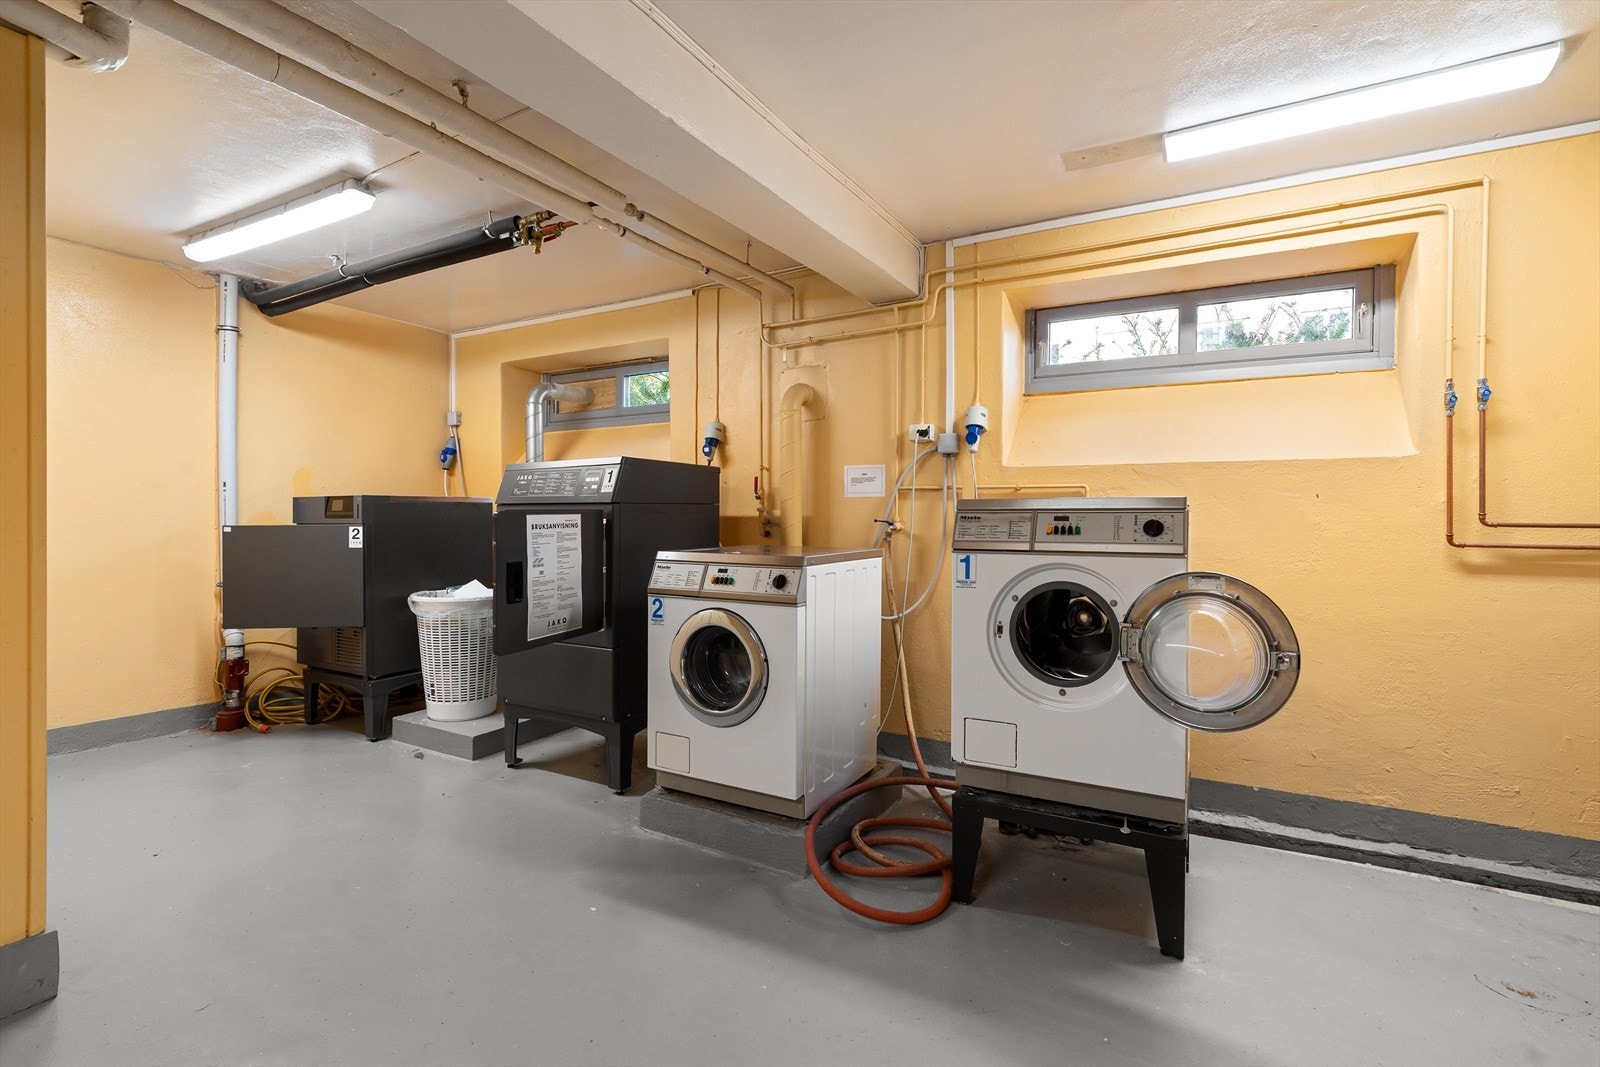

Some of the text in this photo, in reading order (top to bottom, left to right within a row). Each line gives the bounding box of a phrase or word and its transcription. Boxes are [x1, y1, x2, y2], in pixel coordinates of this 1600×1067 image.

[607, 470, 614, 483] 1
[352, 528, 360, 539] 2
[960, 555, 970, 579] 1
[652, 598, 663, 618] 2
[547, 617, 566, 627] JAKO
